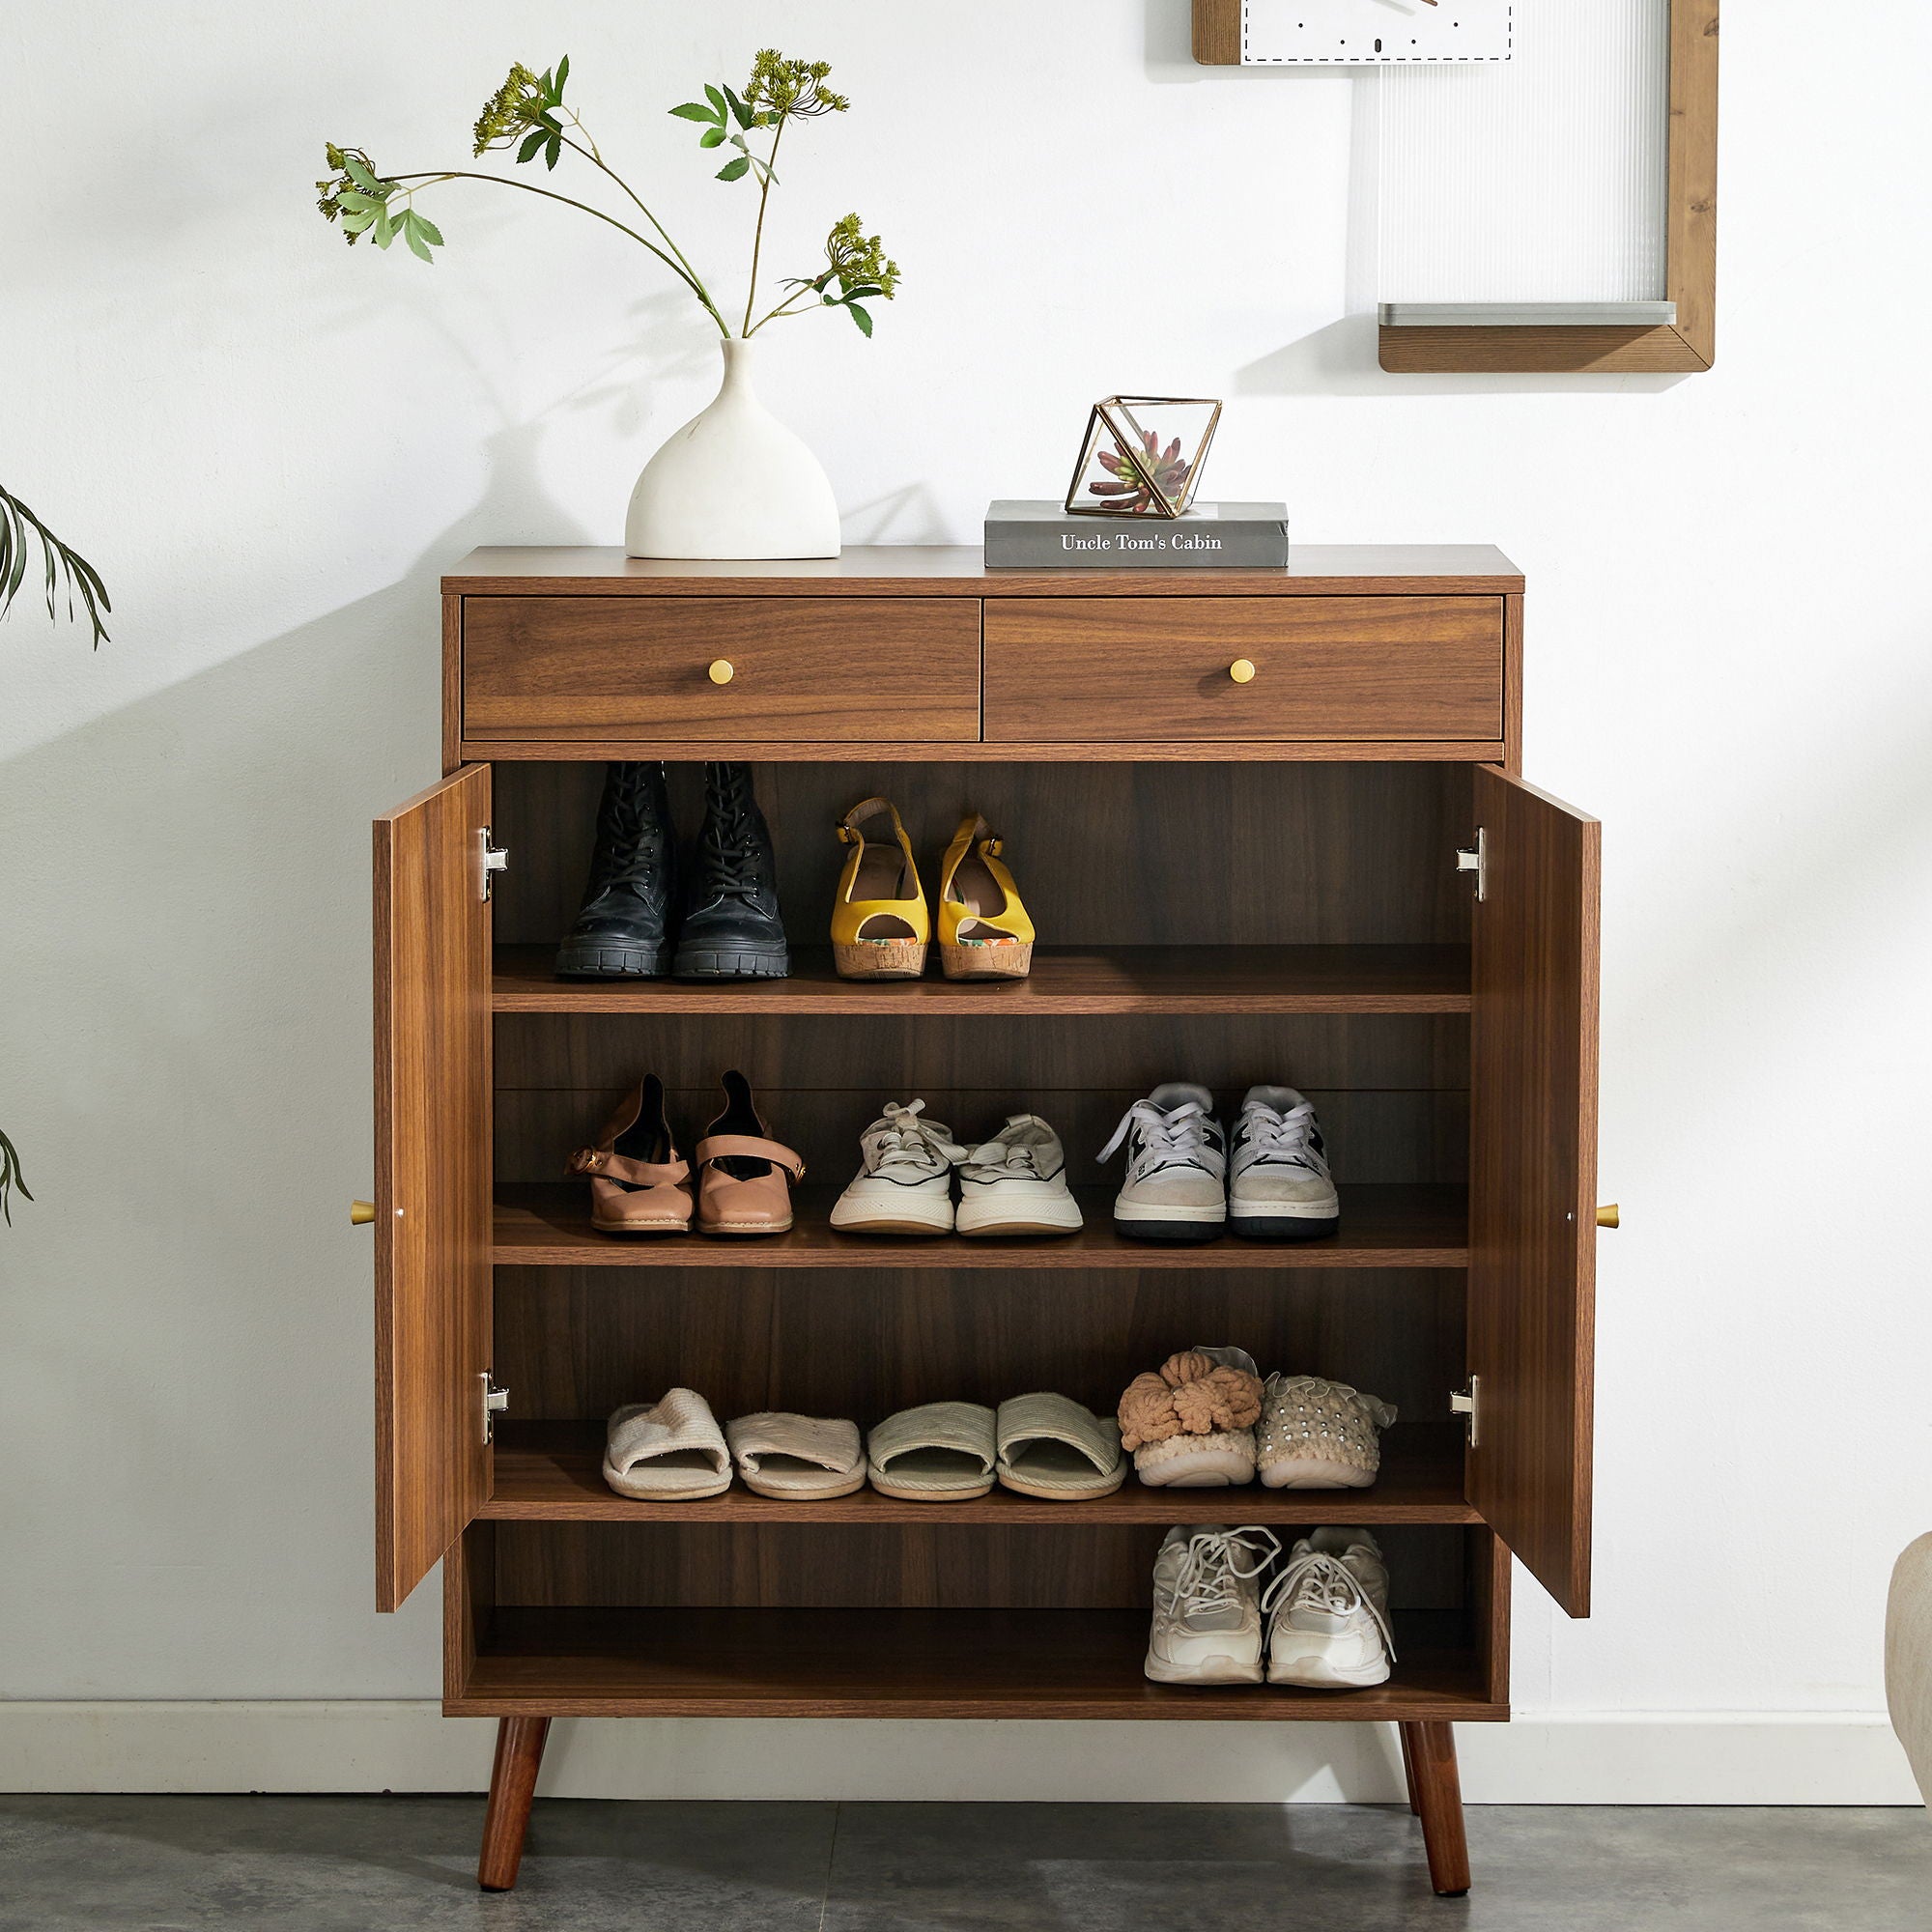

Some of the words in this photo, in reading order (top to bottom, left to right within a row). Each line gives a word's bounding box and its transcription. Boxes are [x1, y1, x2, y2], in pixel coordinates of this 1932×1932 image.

[1061, 534, 1111, 551] Uncle
[1115, 533, 1166, 551] Tom's
[1171, 534, 1223, 551] Cabin
